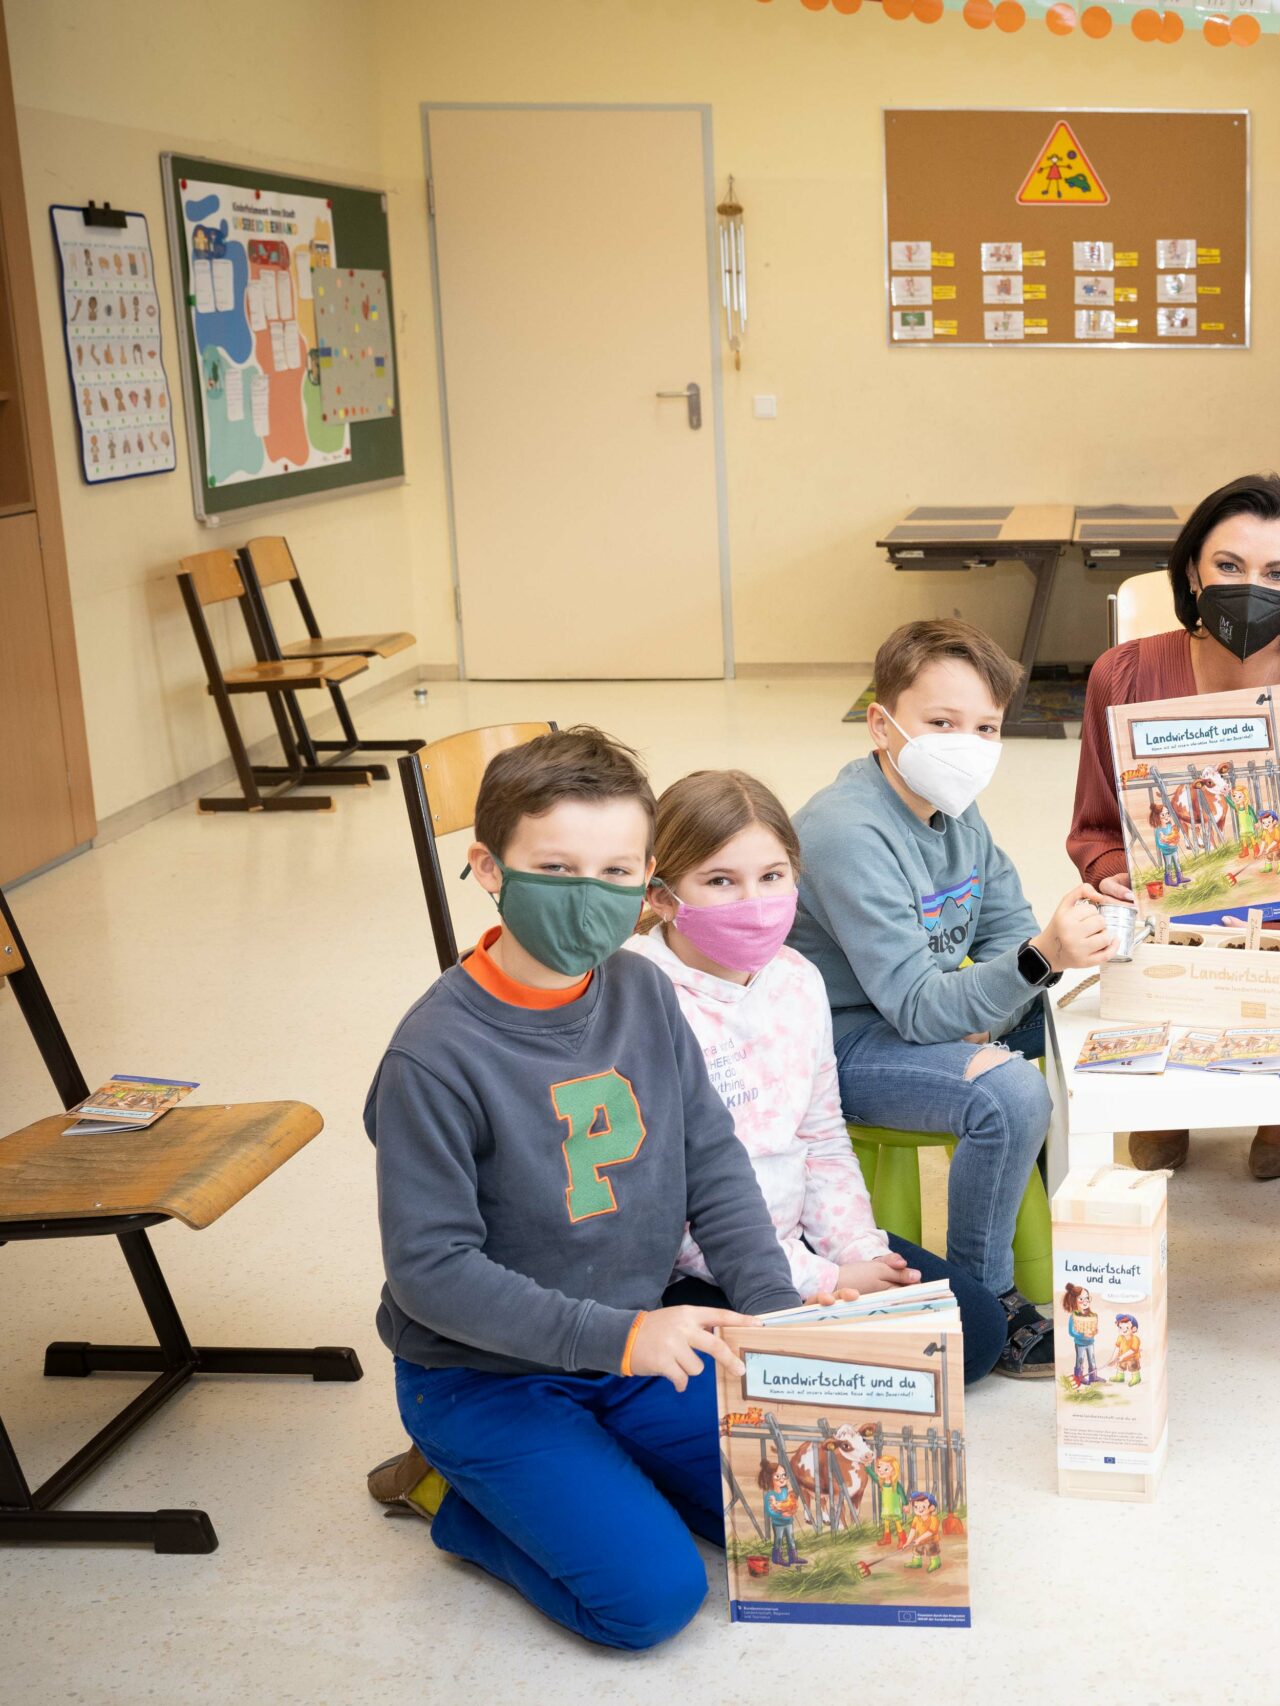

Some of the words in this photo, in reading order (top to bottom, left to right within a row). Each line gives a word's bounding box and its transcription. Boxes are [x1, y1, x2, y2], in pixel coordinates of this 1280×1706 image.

[1145, 725, 1220, 746] Landwirtschaft
[1222, 724, 1239, 736] und
[1242, 722, 1254, 733] du
[726, 1088, 759, 1108] KIND
[550, 1066, 647, 1224] P
[1064, 1258, 1142, 1276] Landwirtschaft
[1086, 1274, 1104, 1284] und
[1108, 1274, 1122, 1285] du
[763, 1369, 866, 1390] Landwirtschaft
[870, 1375, 894, 1388] und
[899, 1376, 917, 1390] du
